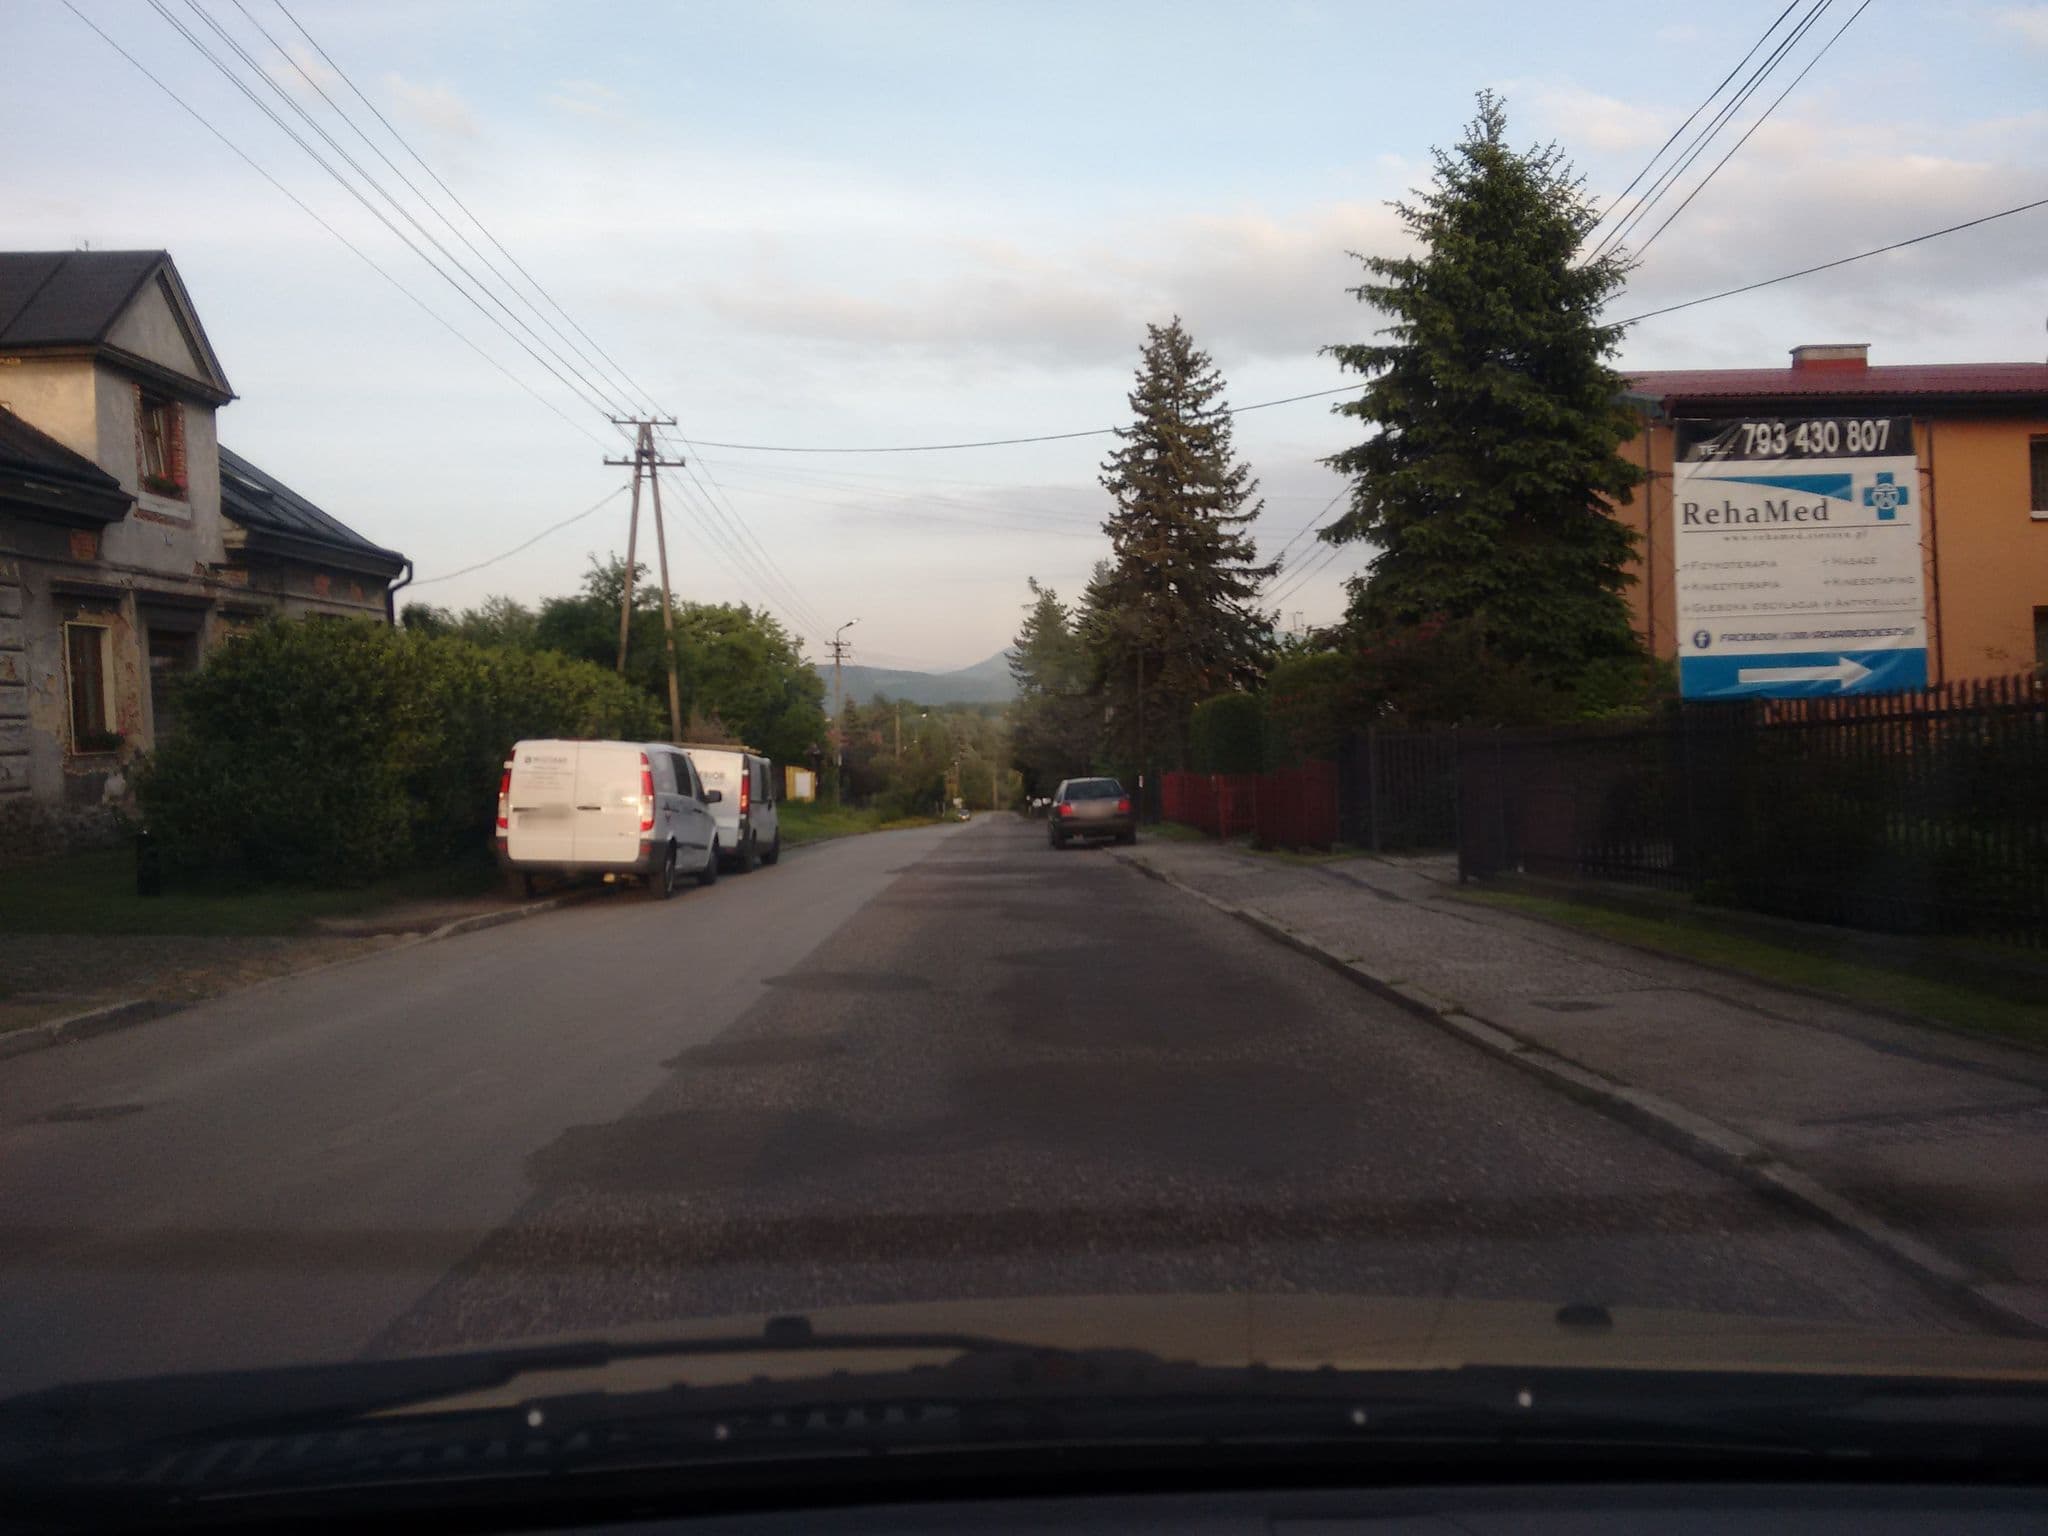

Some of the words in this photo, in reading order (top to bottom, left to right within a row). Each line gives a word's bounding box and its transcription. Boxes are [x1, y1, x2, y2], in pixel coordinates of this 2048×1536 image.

[1742, 422, 1788, 454] 793
[1794, 421, 1840, 453] 430
[1847, 420, 1891, 451] 807
[1682, 498, 1830, 525] RehaMed
